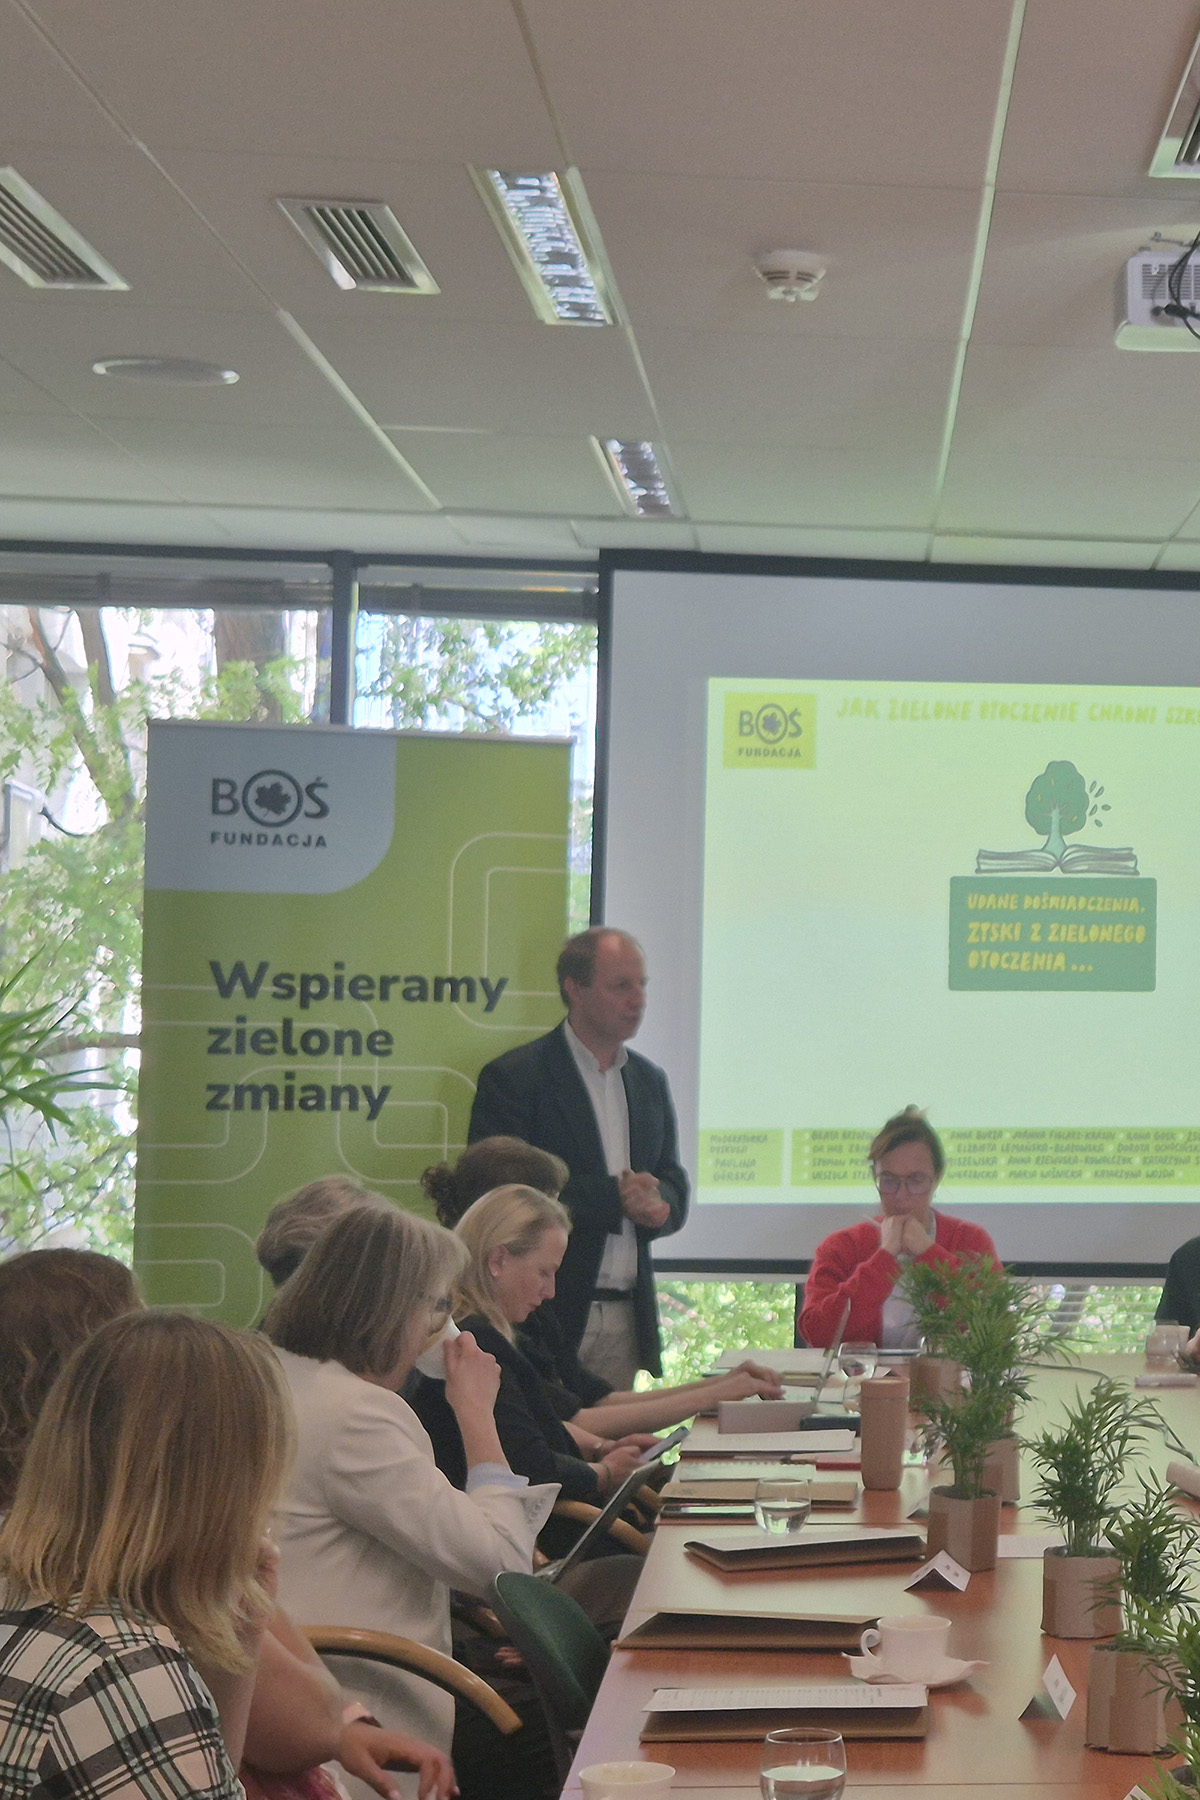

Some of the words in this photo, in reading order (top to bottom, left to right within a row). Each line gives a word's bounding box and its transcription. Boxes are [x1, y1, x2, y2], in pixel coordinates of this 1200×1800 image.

[738, 703, 803, 745] BOŚ
[835, 697, 879, 719] JAK
[887, 698, 972, 722] ZIELONE
[737, 746, 802, 758] FUNDACJA
[211, 768, 331, 828] BOŚ
[210, 831, 328, 849] FUNDACJA
[968, 893, 1018, 911] UDANE
[967, 921, 1022, 944] ZYSKI
[1030, 922, 1042, 943] Z
[1048, 923, 1147, 945] ZIELONEGO
[209, 960, 510, 1014] Wspieramy
[206, 1015, 395, 1057] zielone
[205, 1071, 393, 1121] zmiany
